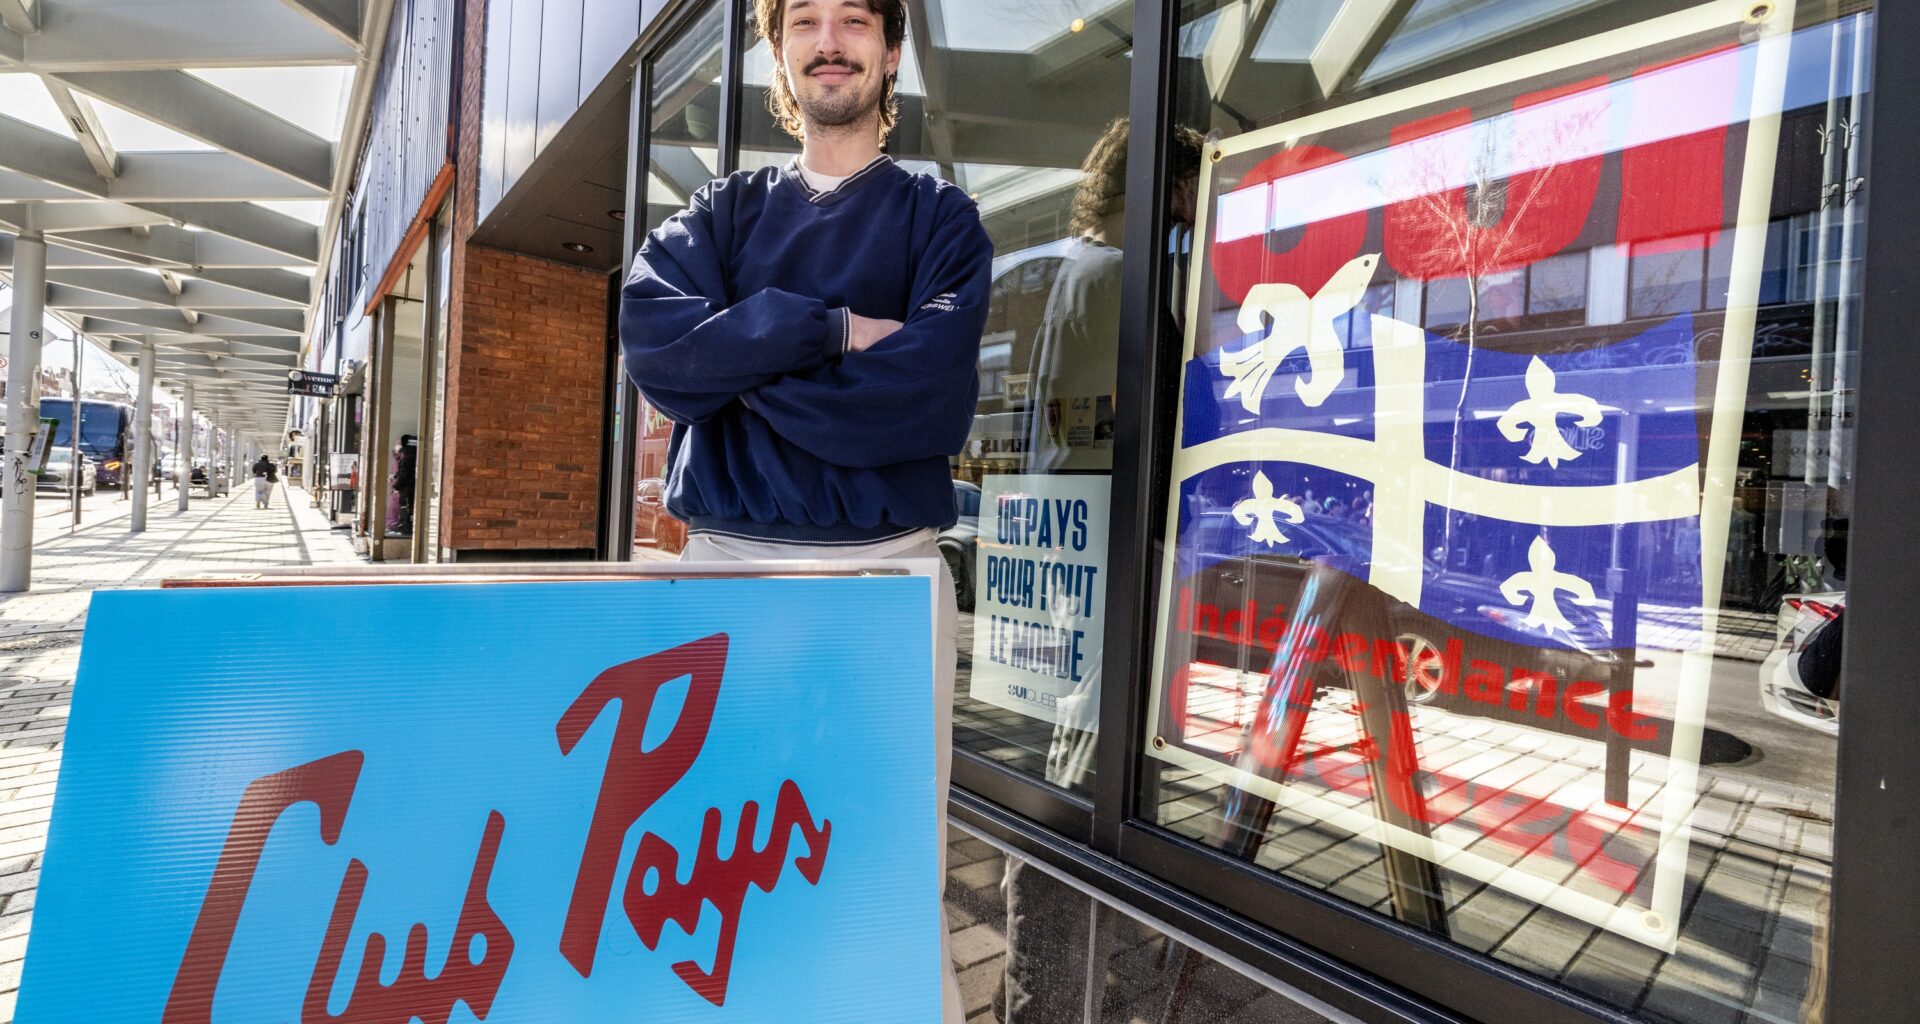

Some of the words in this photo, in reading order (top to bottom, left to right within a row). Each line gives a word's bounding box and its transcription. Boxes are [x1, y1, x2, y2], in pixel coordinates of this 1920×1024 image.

[1211, 44, 1740, 306] OUI
[997, 494, 1023, 546] UN
[1025, 498, 1088, 552] PAYS
[986, 555, 1035, 609] POUR
[1039, 561, 1098, 619] TOUT
[989, 614, 1010, 665] LE
[1011, 619, 1085, 683] MONDE
[161, 750, 515, 1024] Club
[556, 632, 831, 1007] Pays
